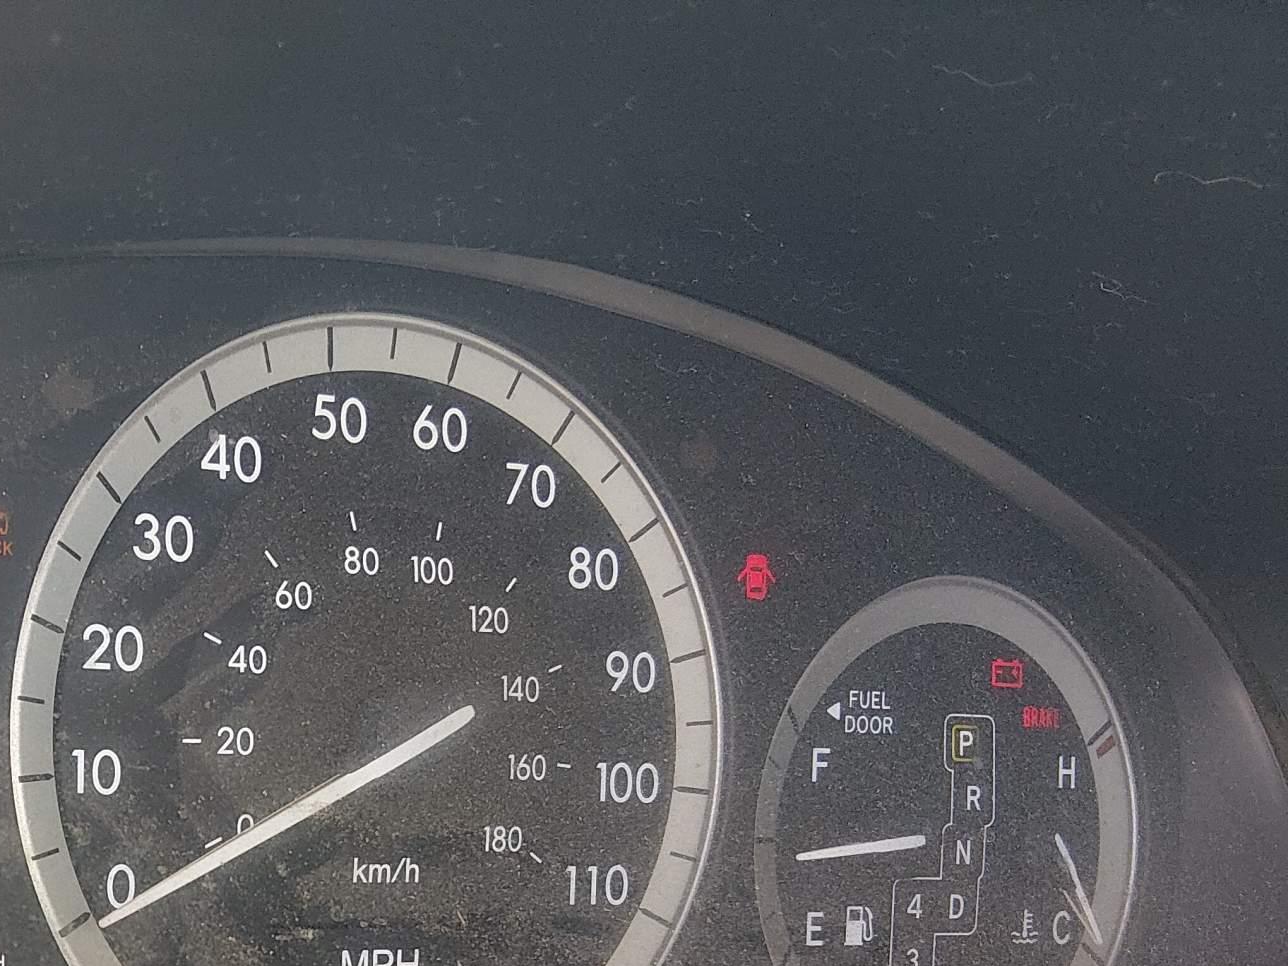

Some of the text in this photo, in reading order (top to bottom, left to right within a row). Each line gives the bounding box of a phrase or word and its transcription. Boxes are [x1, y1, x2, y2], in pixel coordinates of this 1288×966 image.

[312, 394, 367, 443] 50
[413, 405, 467, 452] 60
[201, 434, 261, 482] 40
[505, 463, 556, 508] 70
[132, 513, 194, 562] 30
[344, 546, 380, 576] 80
[411, 555, 454, 585] 100
[568, 547, 619, 591] 80
[276, 581, 312, 610] 60
[468, 606, 509, 635] 120
[81, 624, 144, 673] 20
[228, 646, 268, 675] 40
[606, 650, 655, 694] 90
[501, 674, 540, 703] 140
[849, 690, 891, 709] FUEL
[844, 715, 893, 734] DOOR
[1022, 706, 1060, 729] BRAKE
[216, 727, 255, 755] 20
[958, 731, 974, 755] P
[71, 749, 121, 795] 10
[508, 754, 547, 782] 160
[811, 747, 831, 782] F
[1057, 756, 1076, 789] H
[596, 762, 659, 805] 100
[966, 786, 981, 810] R
[482, 826, 523, 854] 180
[956, 840, 971, 864] N
[106, 863, 136, 909] 0
[352, 858, 420, 884] km/h
[565, 864, 628, 906] 110
[906, 894, 922, 918] 4
[949, 894, 964, 919] D
[806, 911, 824, 946] E
[1052, 911, 1070, 945] C
